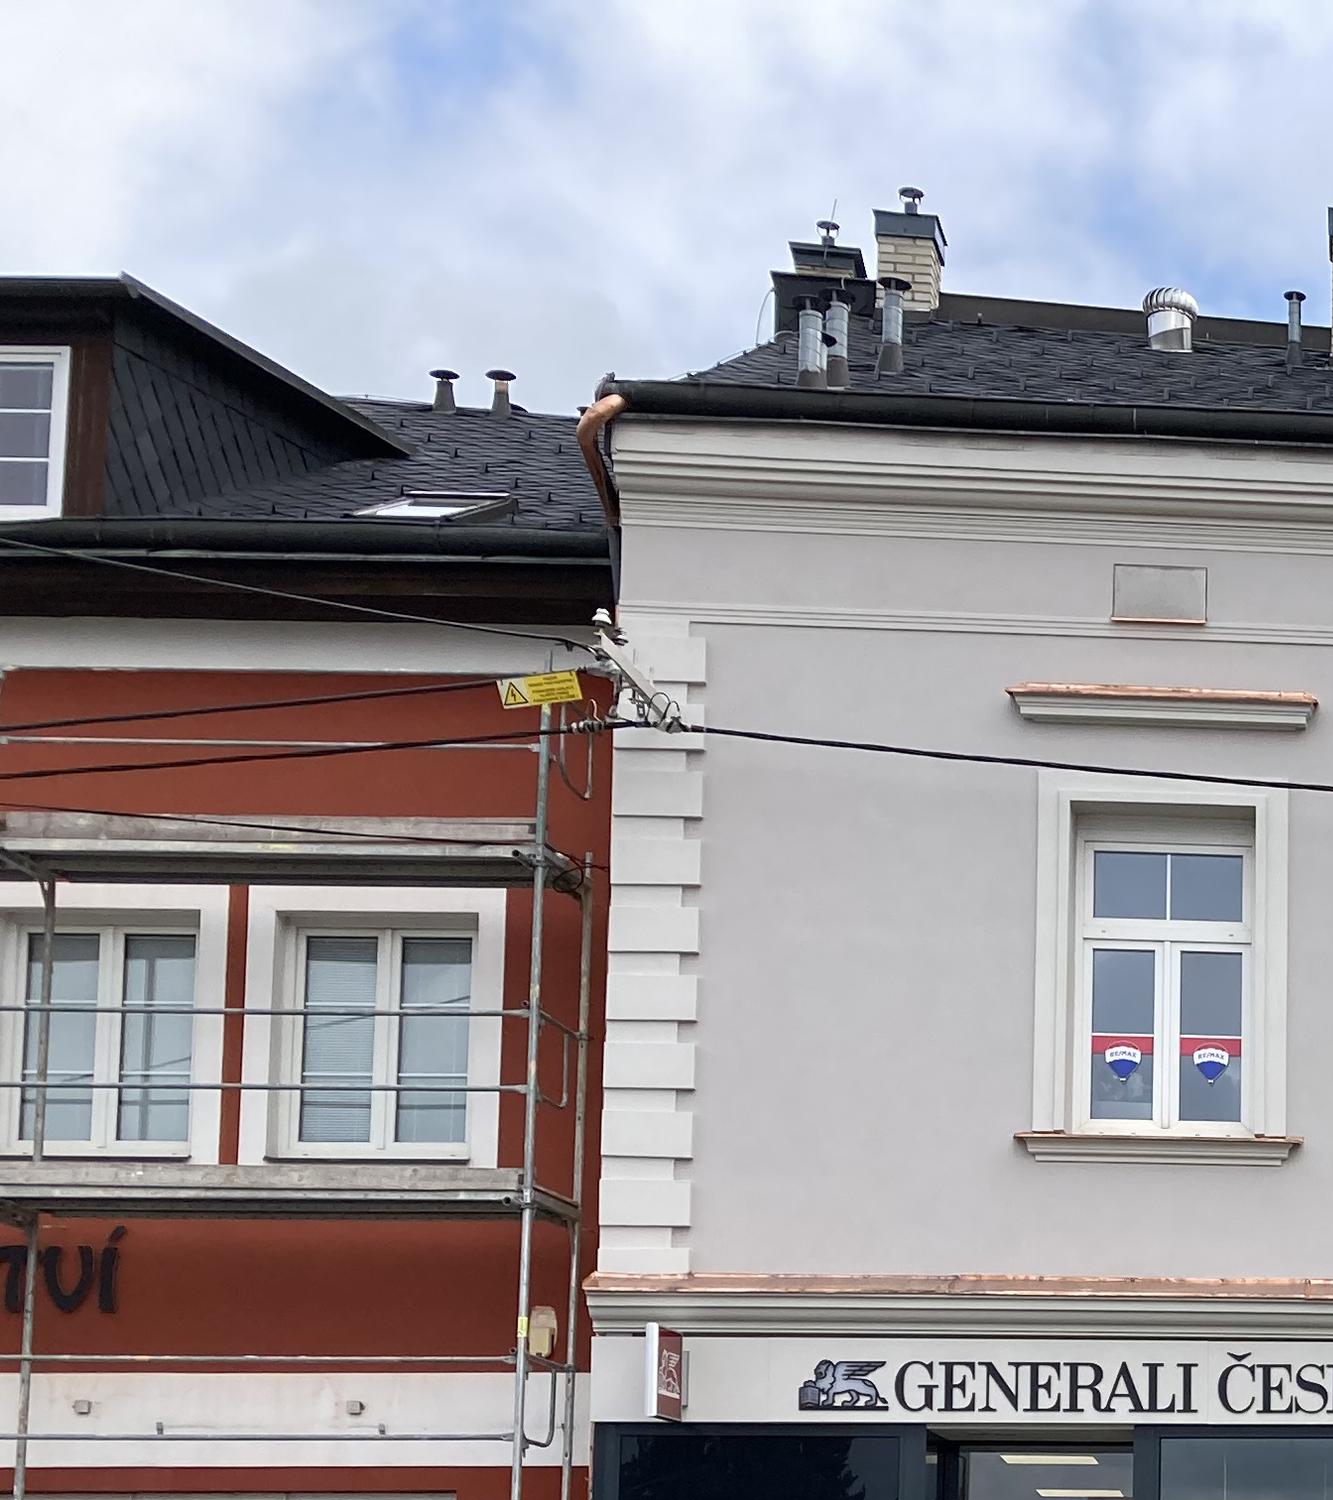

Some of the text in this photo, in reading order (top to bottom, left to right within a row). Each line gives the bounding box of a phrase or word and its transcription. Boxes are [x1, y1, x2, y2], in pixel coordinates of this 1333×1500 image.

[1109, 1051, 1137, 1059] RE/MAX
[1197, 1052, 1225, 1061] RE/MAX
[894, 1360, 1199, 1414] GENERALI
